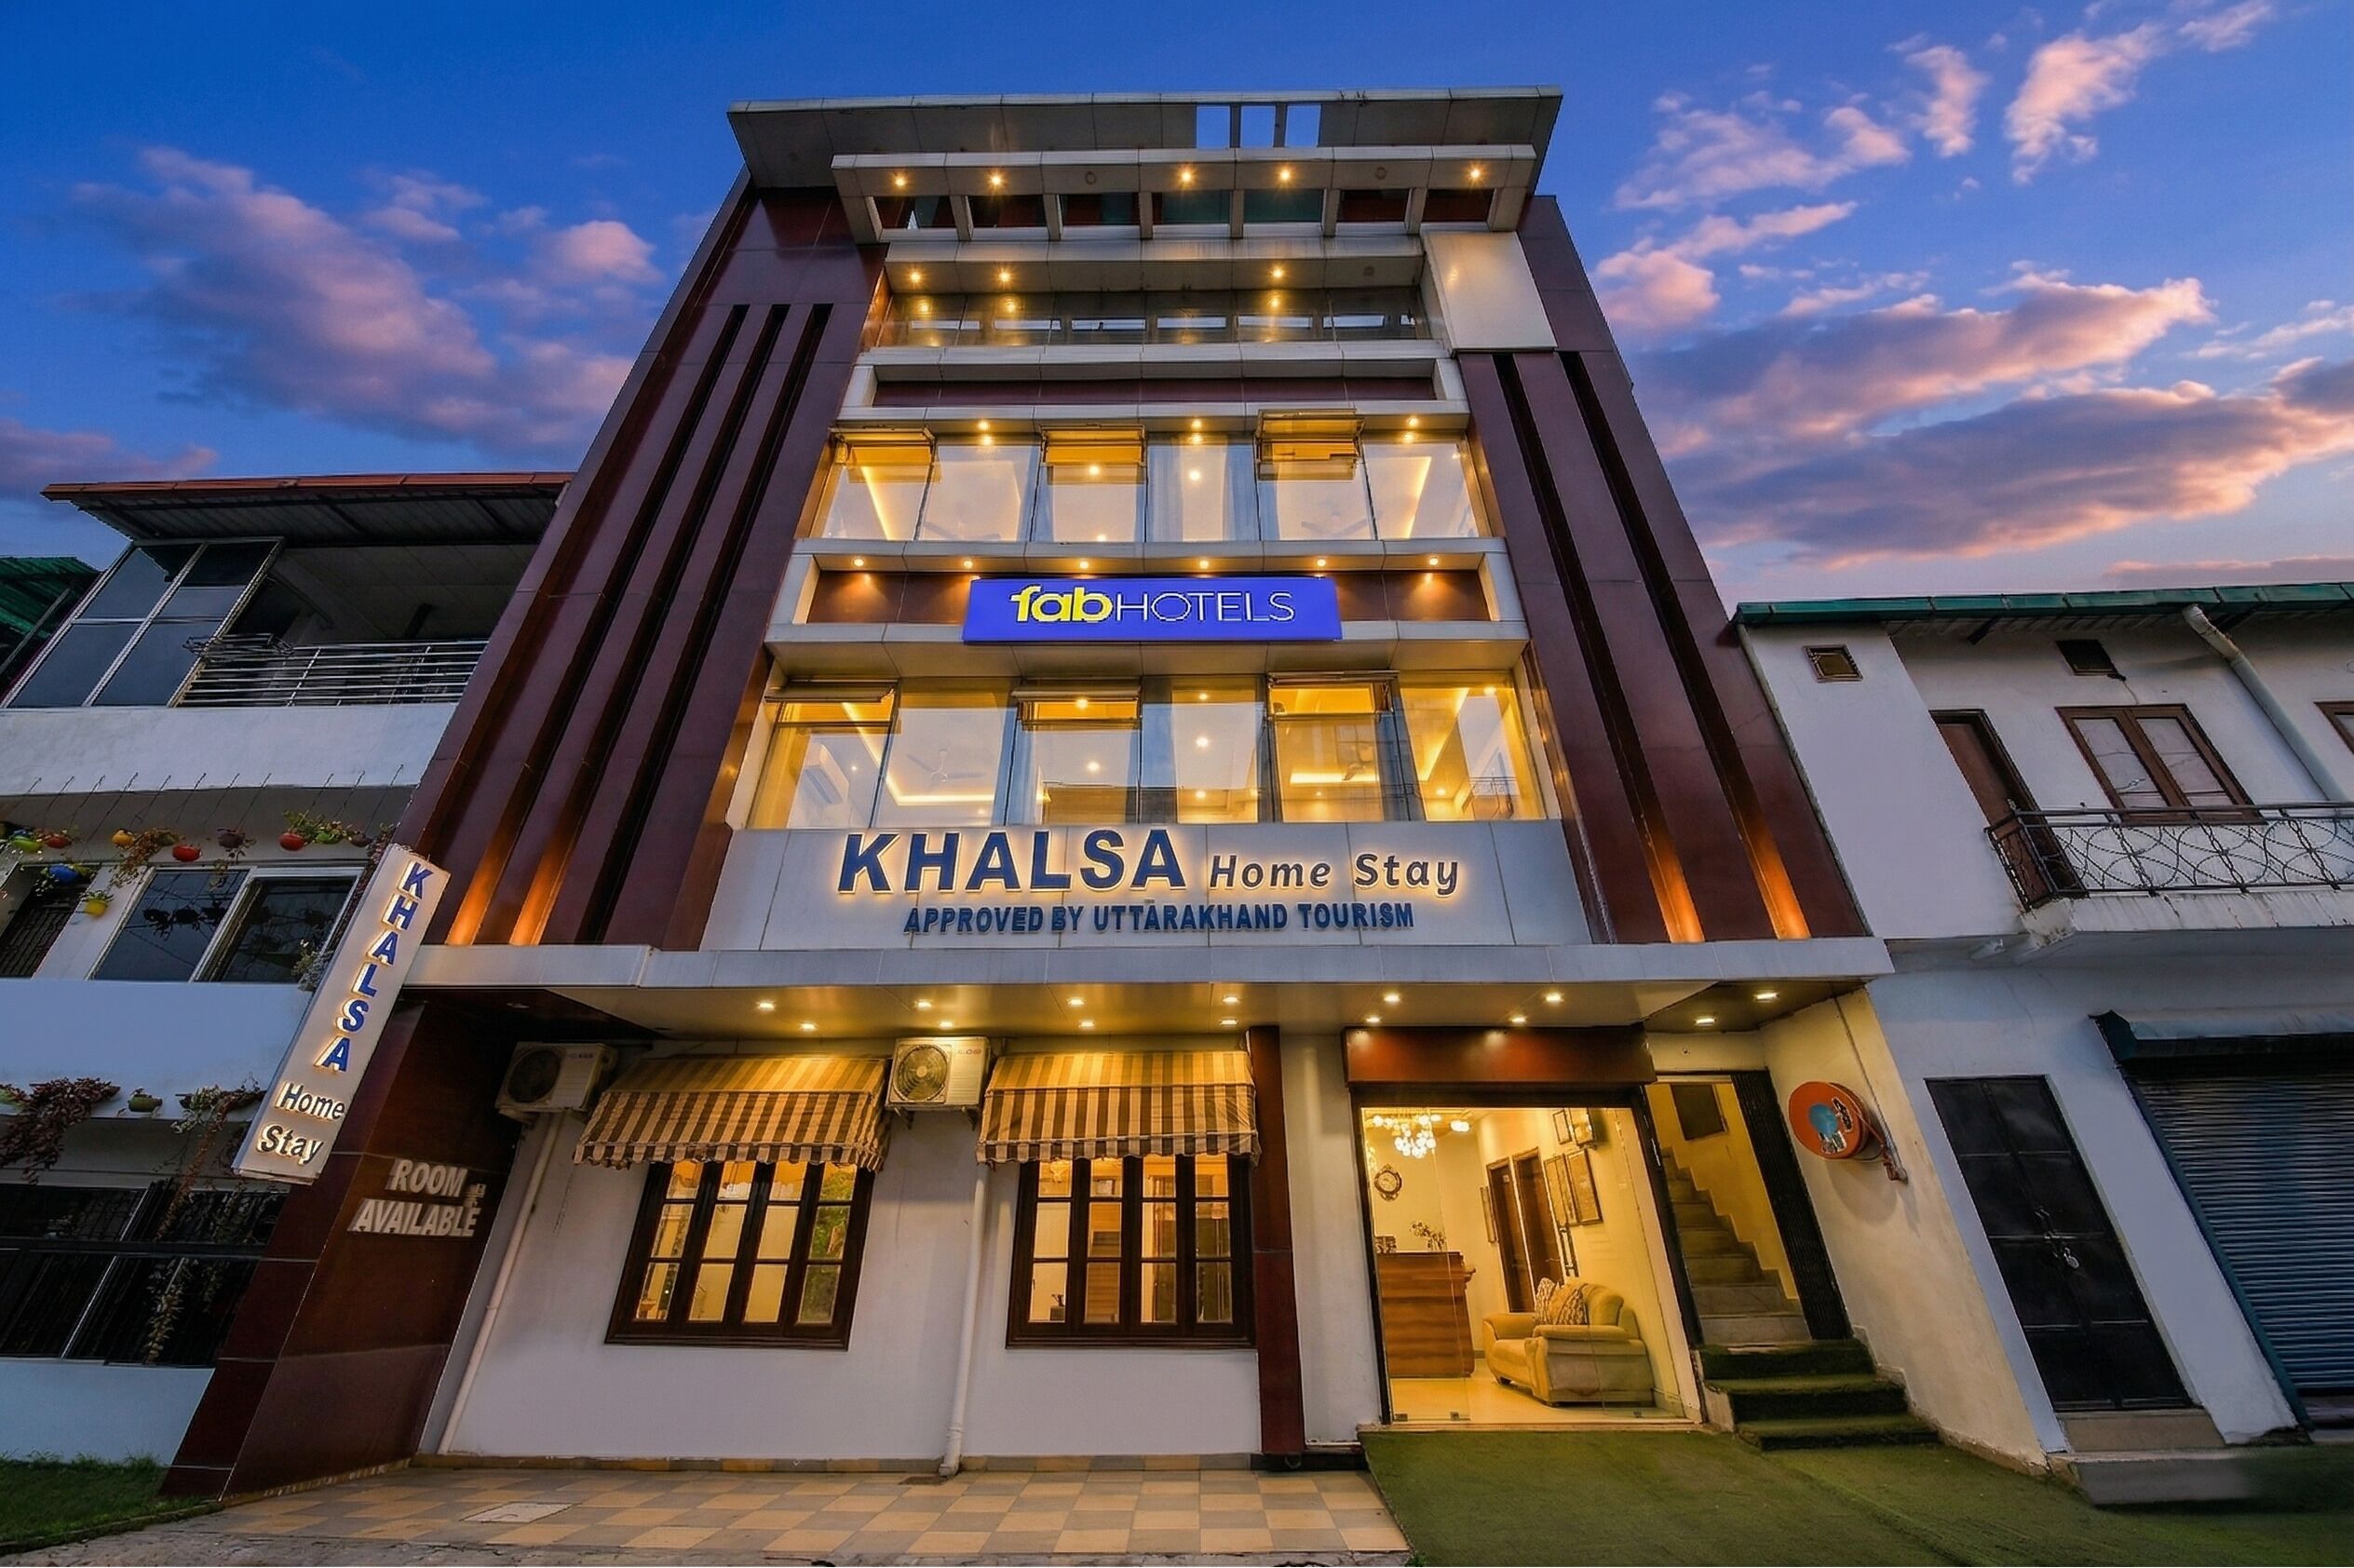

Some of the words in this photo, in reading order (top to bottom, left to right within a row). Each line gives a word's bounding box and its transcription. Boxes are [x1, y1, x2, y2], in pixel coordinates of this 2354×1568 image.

[1010, 585, 1295, 623] fabHOTELS
[837, 828, 1187, 893] KHALSA
[1210, 854, 1332, 888] Home
[1354, 852, 1458, 897] Stay
[903, 905, 1044, 933] APPROVED
[1050, 904, 1084, 931] BY
[1093, 903, 1289, 930] UTTARAKHAND
[1297, 901, 1415, 929] TOURISM
[315, 860, 434, 1073] KHALSA
[276, 1082, 345, 1120] Home
[257, 1123, 325, 1165] Stay
[385, 1158, 468, 1198] ROOM
[347, 1197, 481, 1237] AVAILABLE
